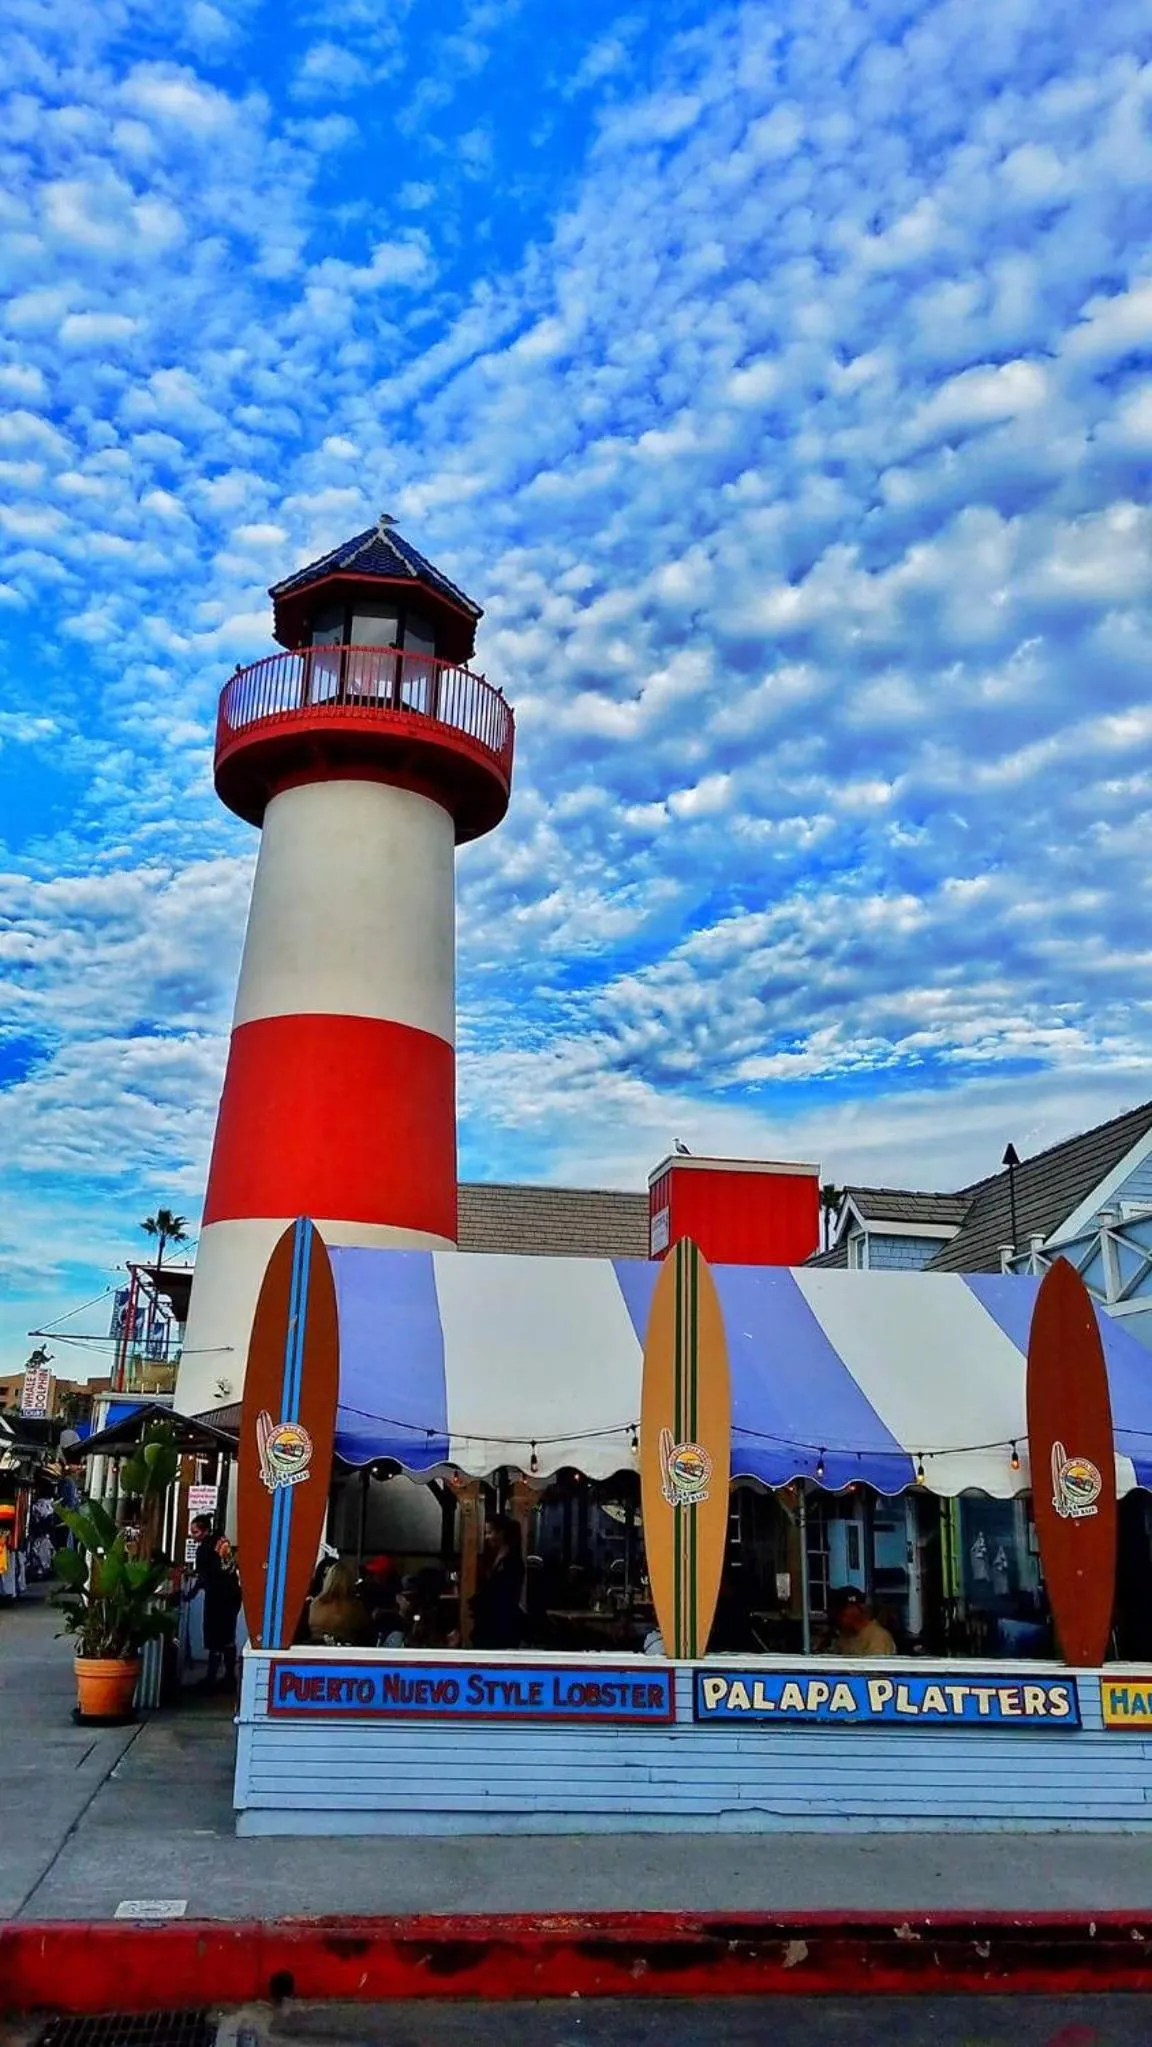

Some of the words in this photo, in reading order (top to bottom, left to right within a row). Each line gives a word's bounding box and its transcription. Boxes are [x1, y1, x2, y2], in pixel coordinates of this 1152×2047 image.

[24, 1376, 36, 1408] WHALE
[35, 1371, 48, 1408] DOLPHIN
[279, 1671, 376, 1702] PUERTO
[384, 1672, 459, 1704] NUEVO
[465, 1674, 544, 1706] STYLE
[554, 1677, 665, 1709] LOBSTER
[702, 1677, 858, 1712] PALAPA
[867, 1679, 1071, 1717] PLATTERS
[1110, 1688, 1152, 1715] HA
